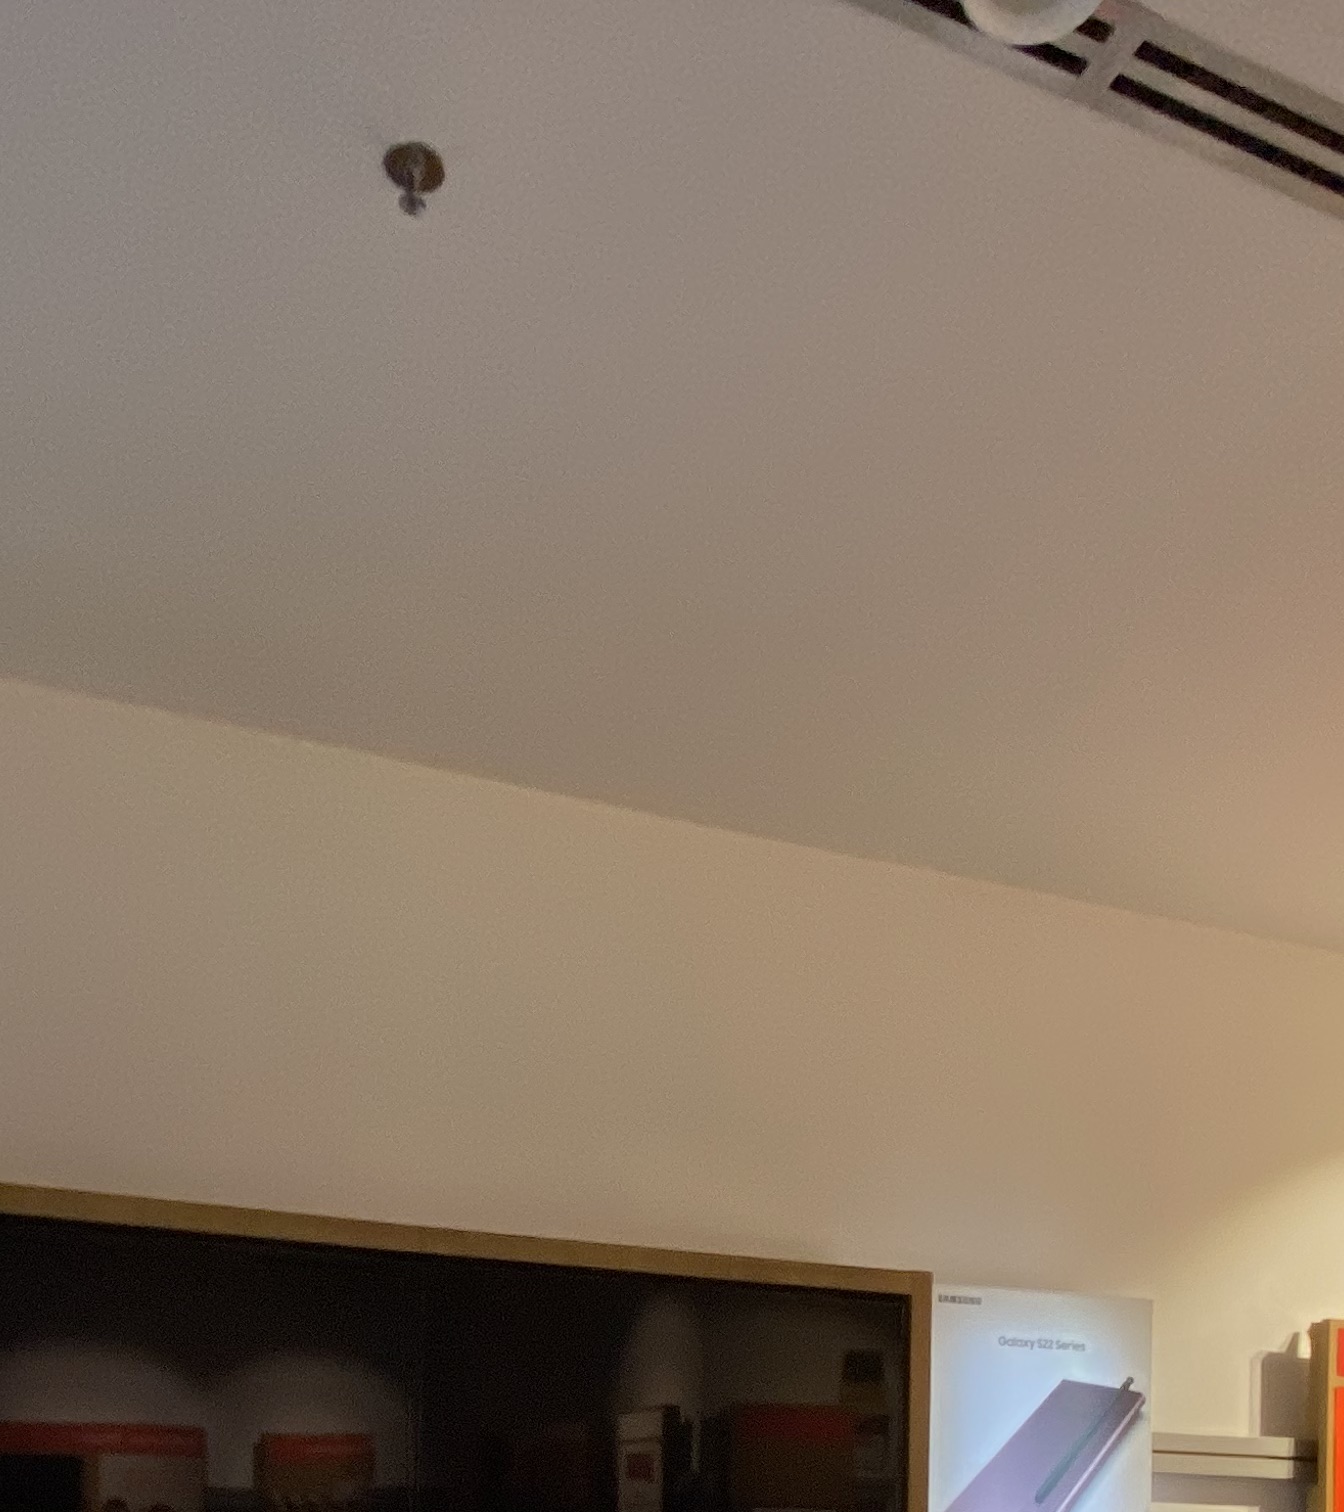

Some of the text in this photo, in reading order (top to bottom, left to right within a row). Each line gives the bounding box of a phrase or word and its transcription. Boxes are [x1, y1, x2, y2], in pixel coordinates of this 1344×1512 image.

[998, 1335, 1086, 1352] Galaxy S22 Series
